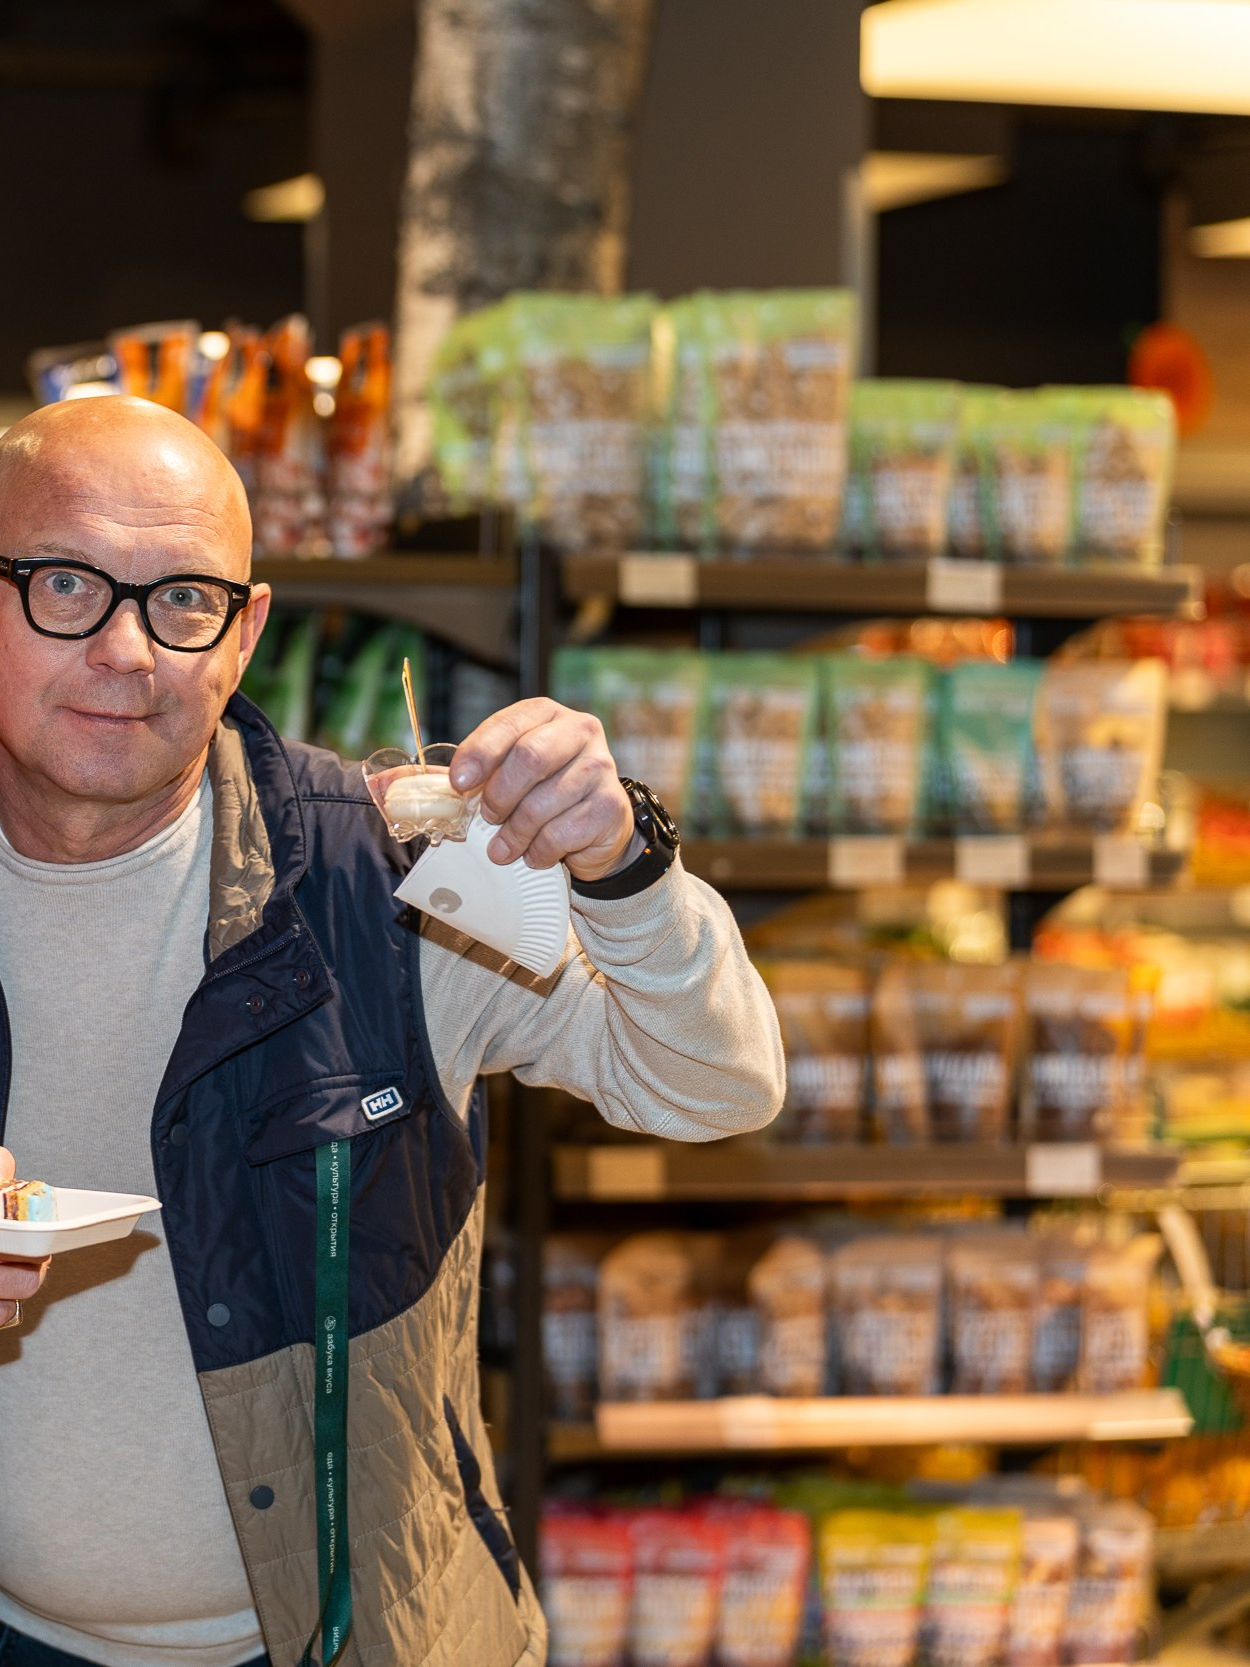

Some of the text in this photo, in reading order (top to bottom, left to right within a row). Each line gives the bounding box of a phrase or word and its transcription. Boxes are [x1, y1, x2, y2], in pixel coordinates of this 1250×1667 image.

[329, 1161, 339, 1204] культура
[329, 1212, 338, 1258] открытия
[325, 1333, 336, 1394] азбука вкуса
[326, 1451, 334, 1470] еда
[326, 1477, 336, 1520] культура
